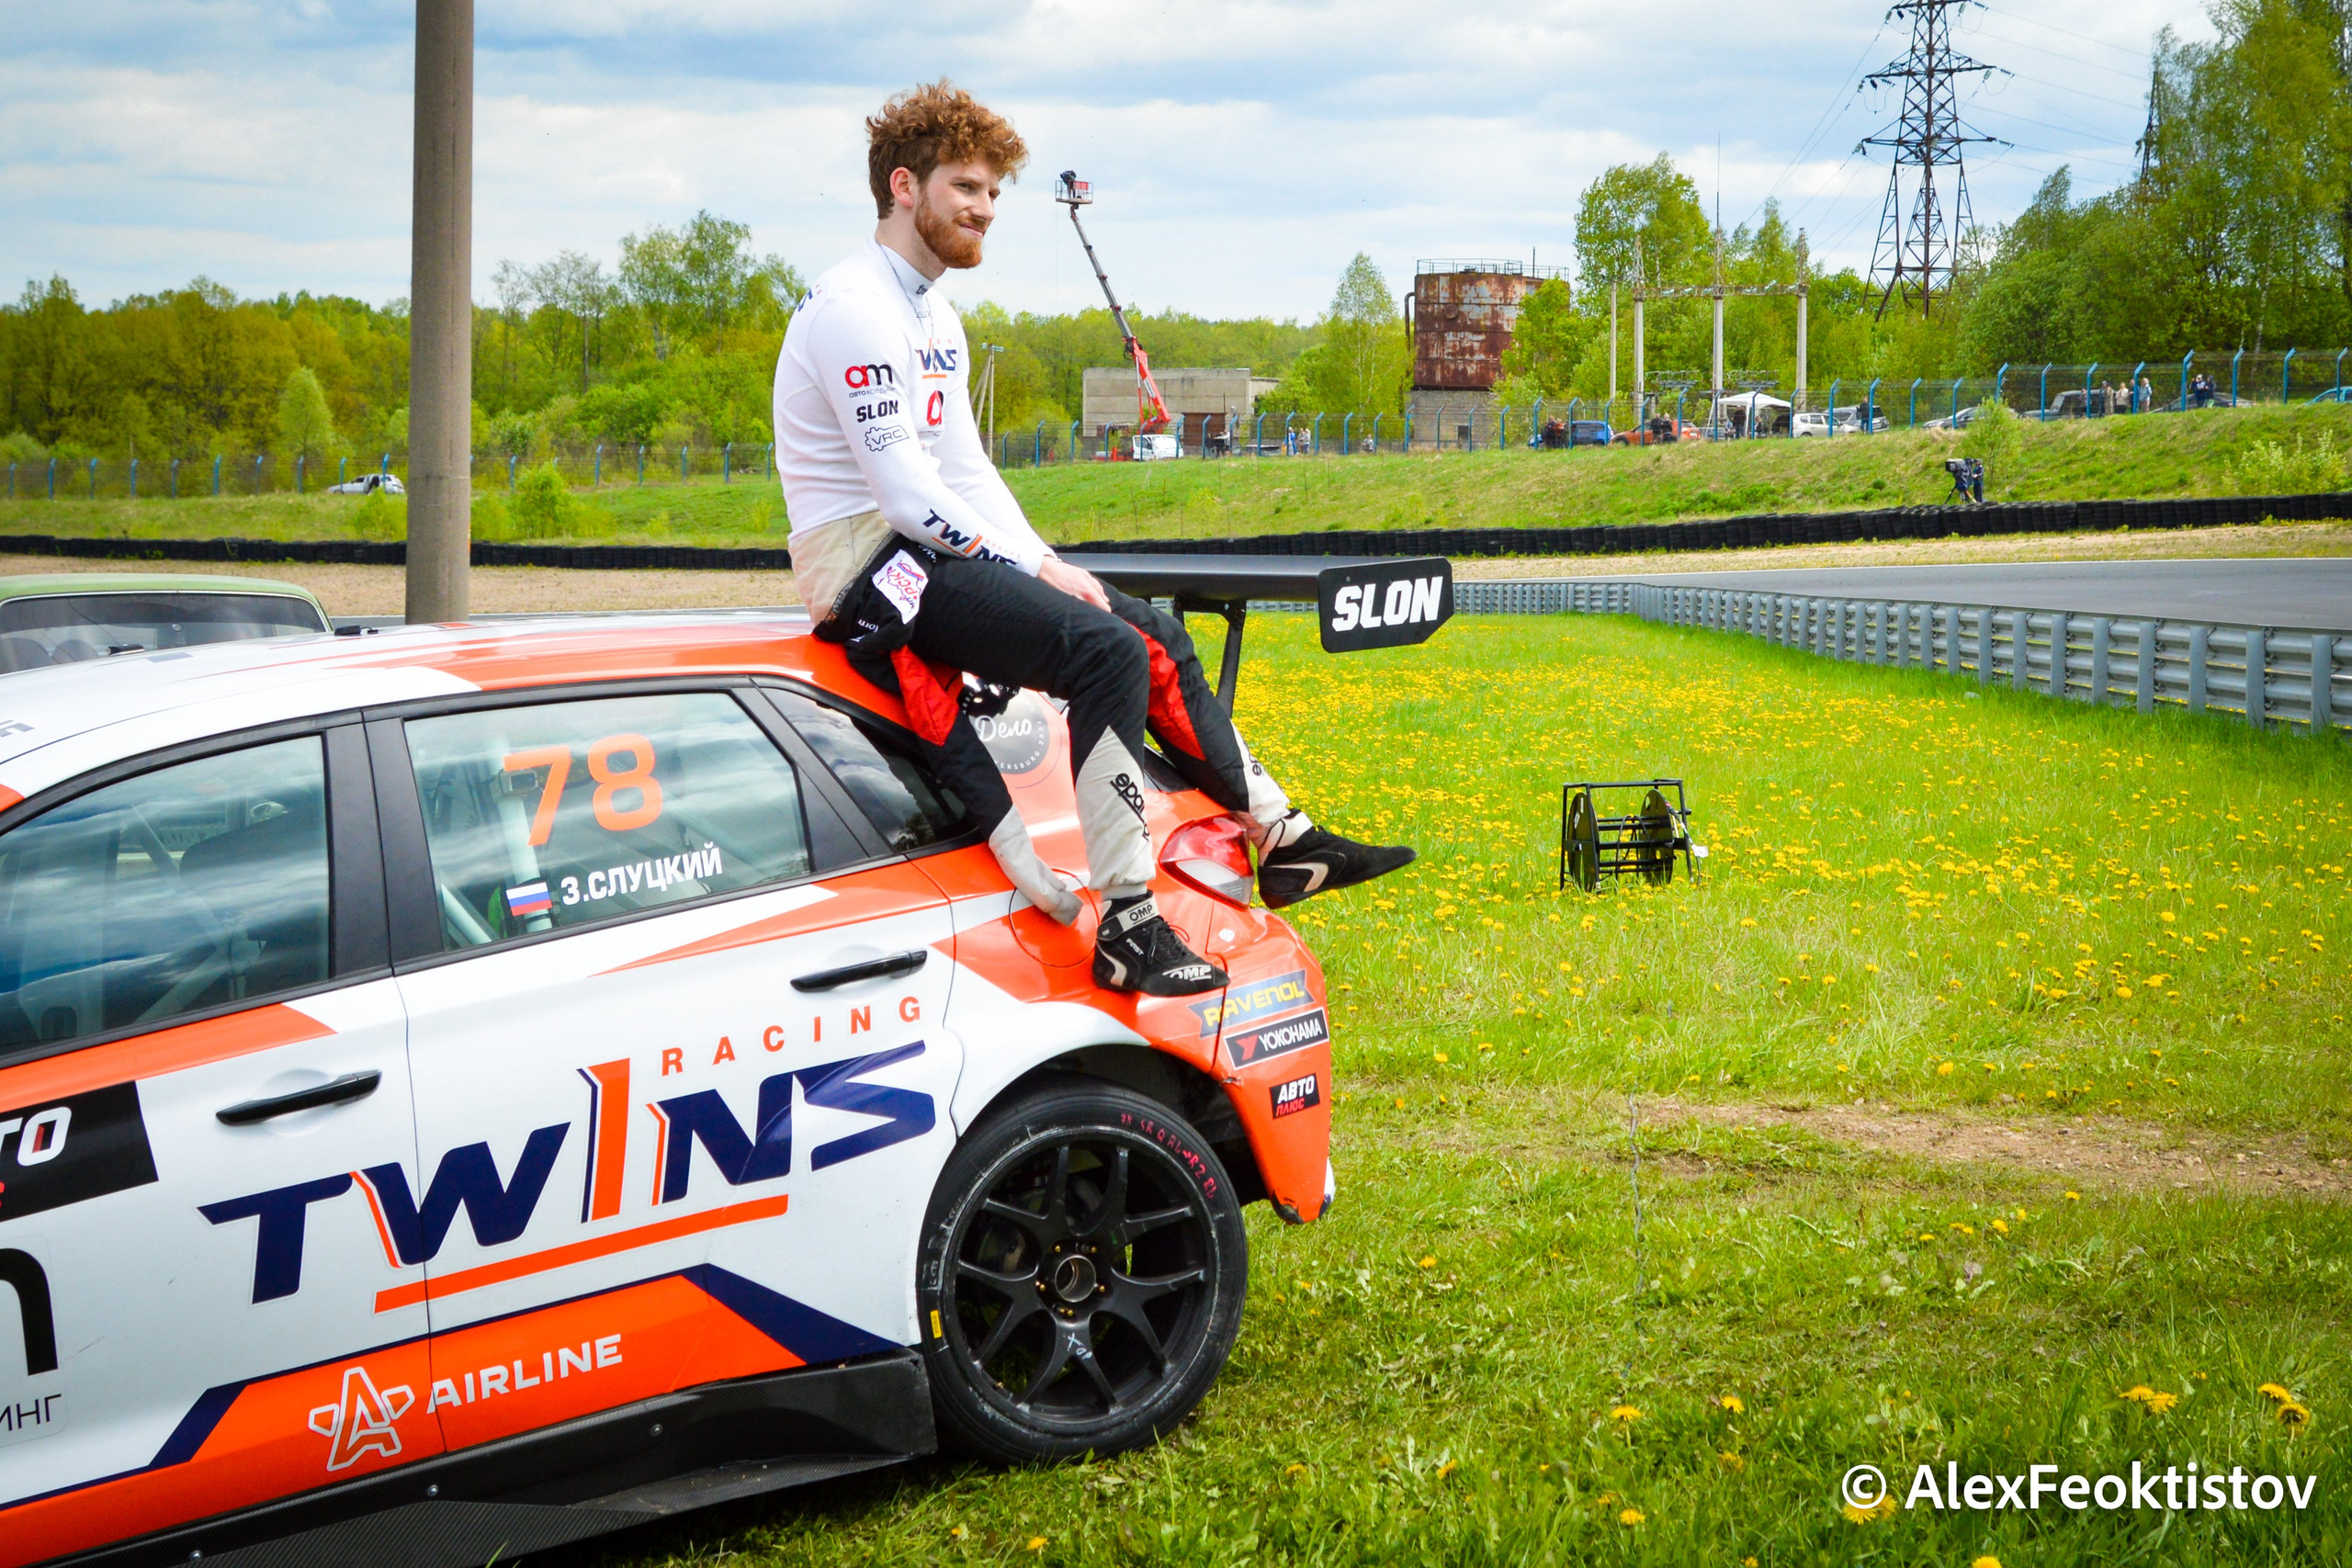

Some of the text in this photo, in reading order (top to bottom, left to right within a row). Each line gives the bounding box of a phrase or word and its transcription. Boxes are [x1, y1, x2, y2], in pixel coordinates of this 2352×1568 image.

[856, 400, 899, 423] SLON
[871, 429, 902, 446] VRC
[1332, 576, 1443, 632] SLON
[974, 715, 1033, 742] Дело
[503, 733, 662, 846] 78
[560, 841, 723, 906] З.СЛУЦКИЙ
[1128, 904, 1153, 921] OMP
[1125, 938, 1144, 956] FIRST
[1203, 980, 1305, 1027] RAVENOL
[662, 997, 921, 1077] RACING
[1259, 1018, 1322, 1052] YOKOHAMA
[1277, 1076, 1315, 1104] АВТО
[1275, 1098, 1305, 1117] ПЛЮС
[197, 1040, 936, 1305] TWINS
[426, 1335, 623, 1415] AIRLINE
